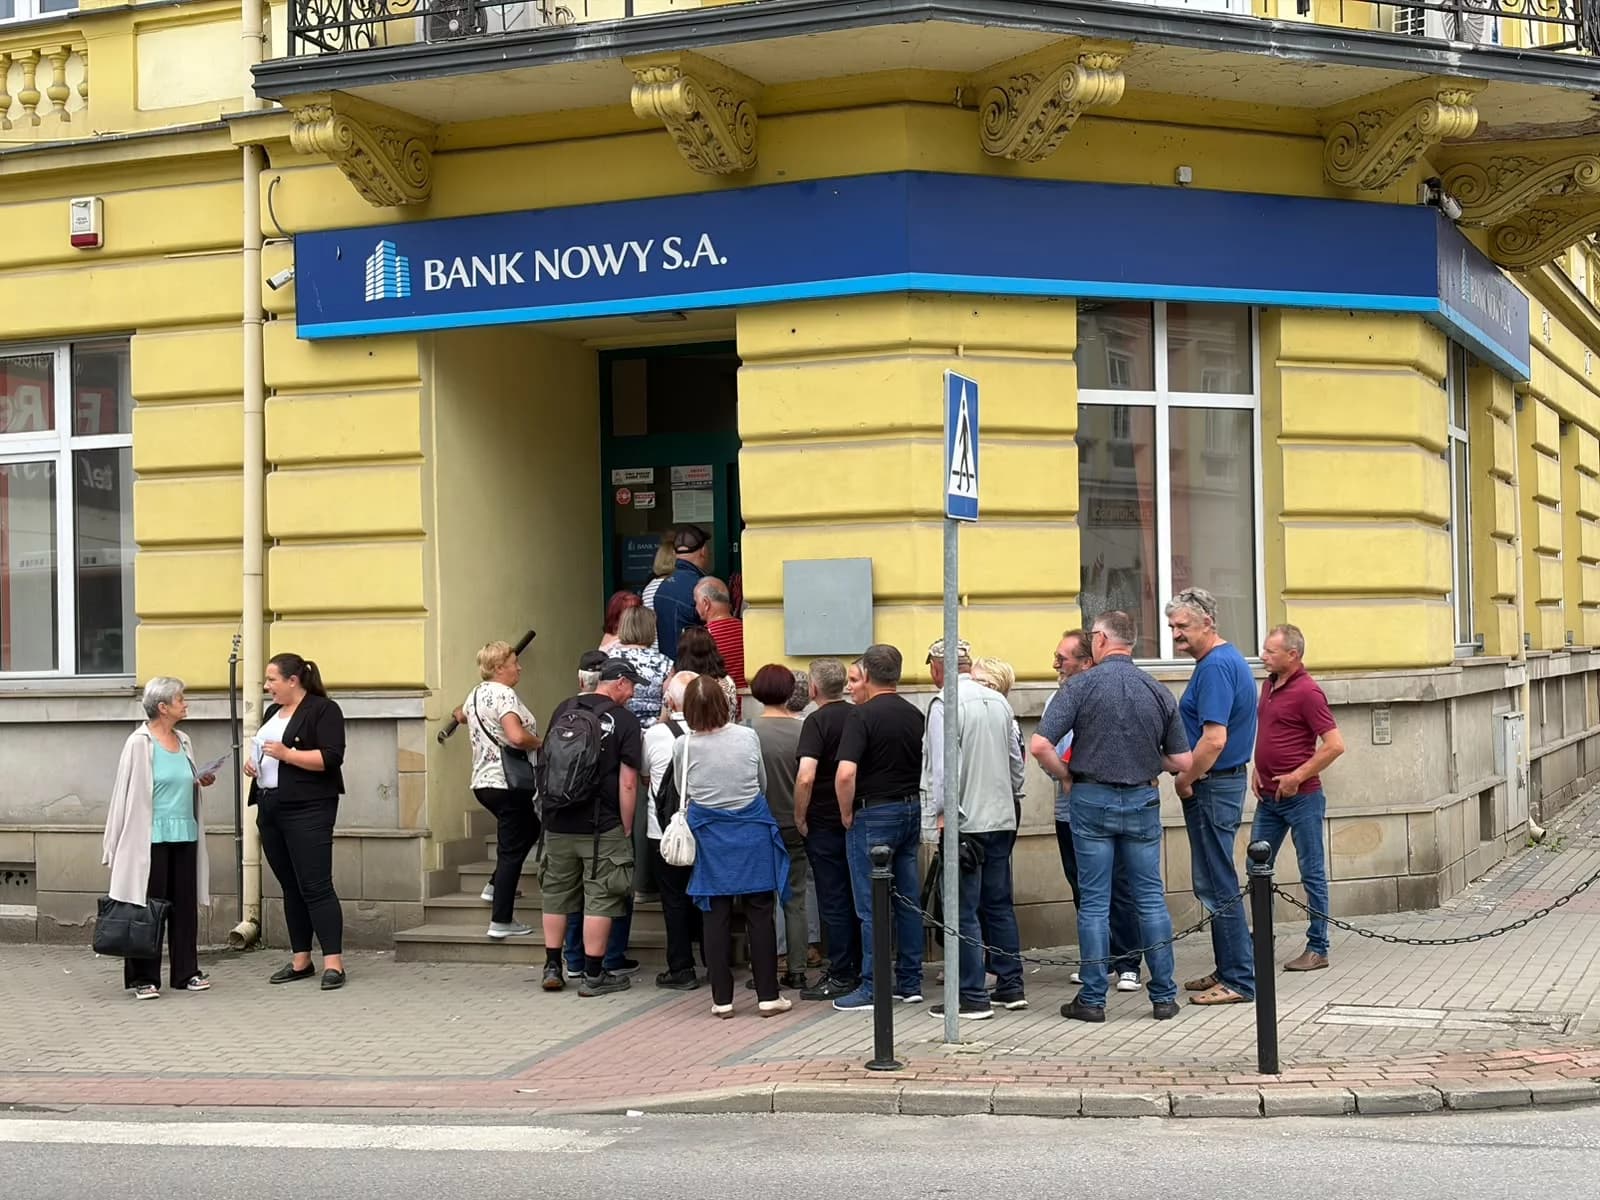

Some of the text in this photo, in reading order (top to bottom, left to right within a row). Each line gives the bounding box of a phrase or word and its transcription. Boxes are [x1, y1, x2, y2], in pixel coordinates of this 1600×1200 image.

[424, 232, 728, 292] BANK NOWY S.A.
